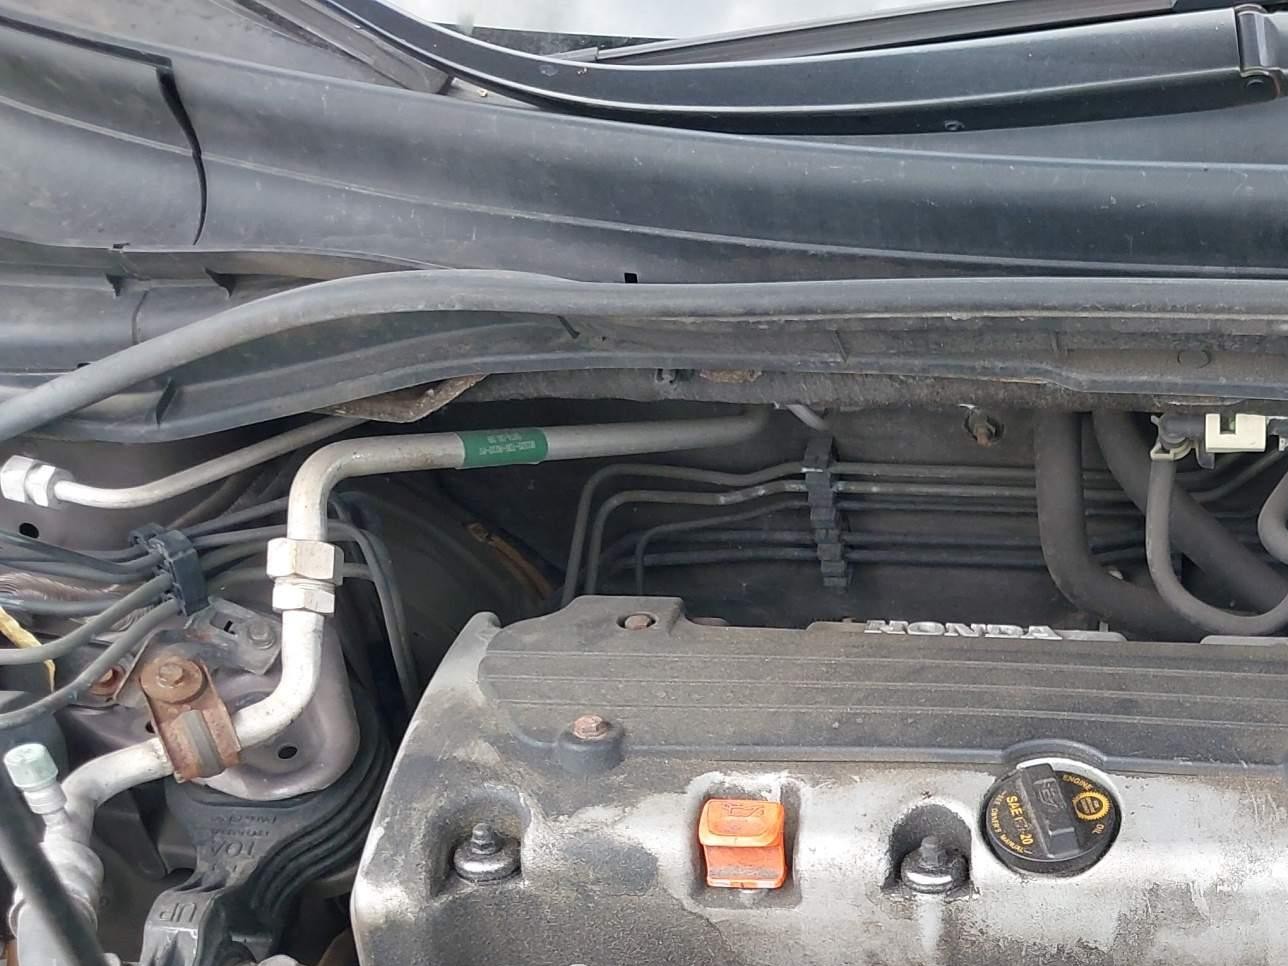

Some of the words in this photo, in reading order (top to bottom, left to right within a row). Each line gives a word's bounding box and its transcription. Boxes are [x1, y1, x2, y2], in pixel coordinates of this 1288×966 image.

[864, 619, 1063, 641] HONDA
[1063, 774, 1093, 791] ENGINE
[1006, 795, 1023, 817] SAE
